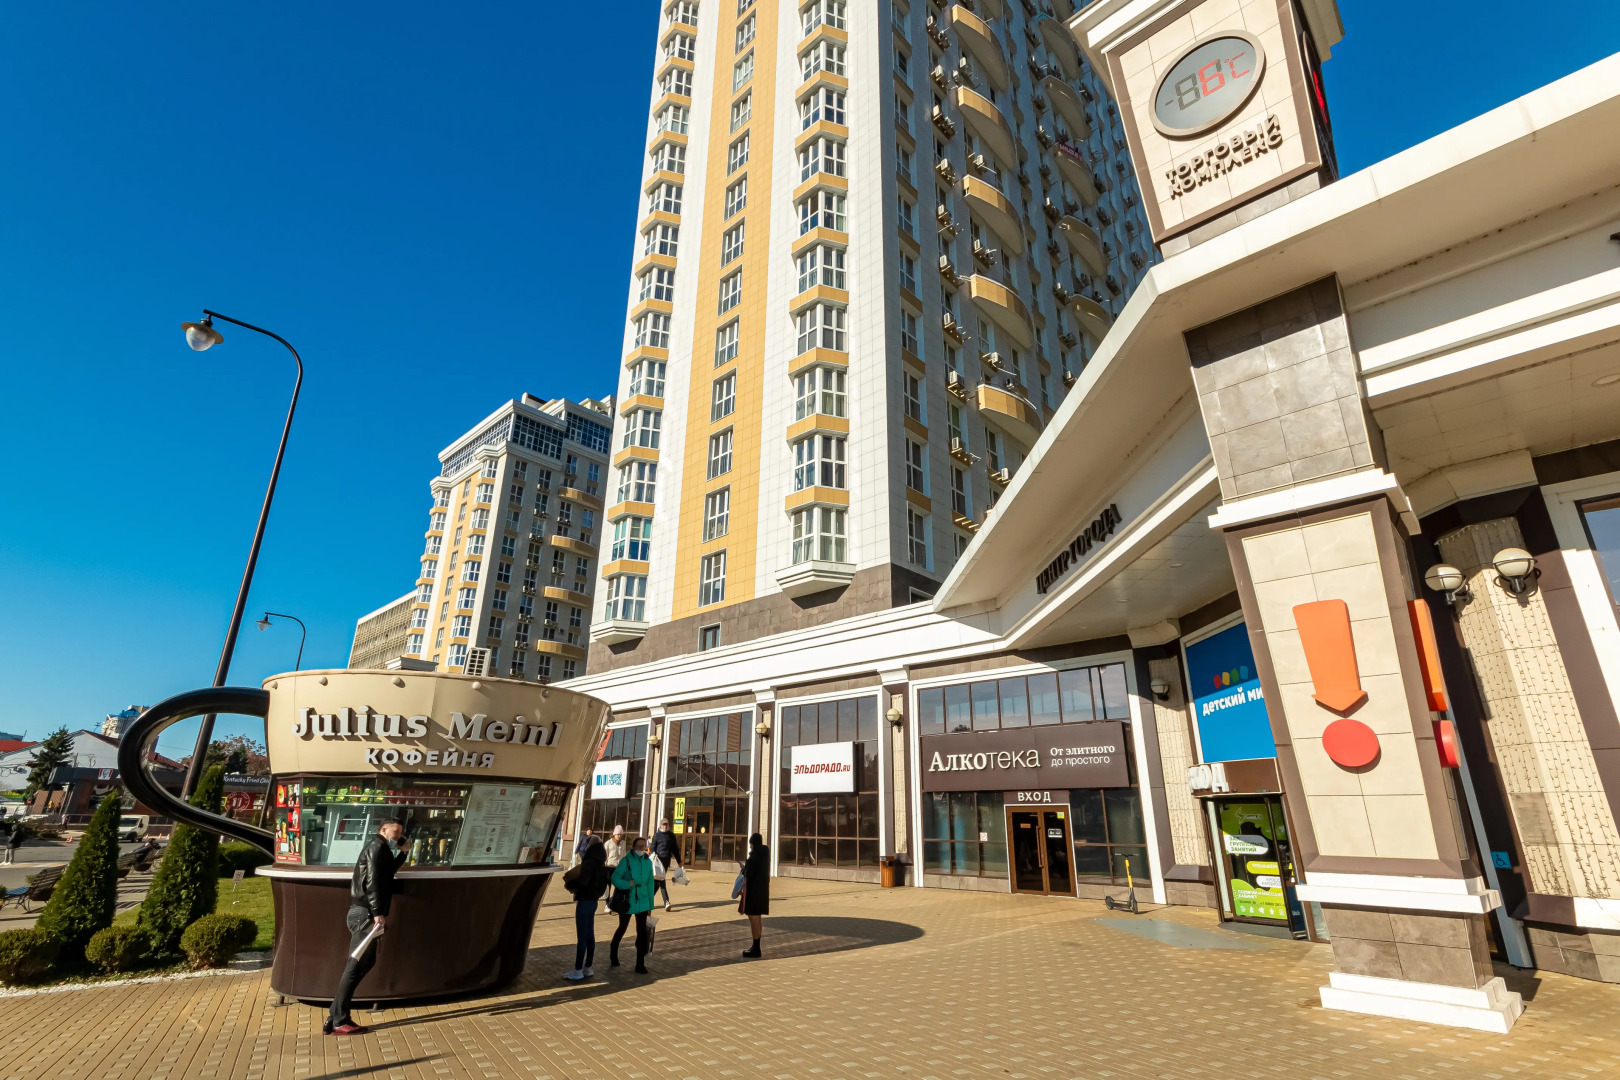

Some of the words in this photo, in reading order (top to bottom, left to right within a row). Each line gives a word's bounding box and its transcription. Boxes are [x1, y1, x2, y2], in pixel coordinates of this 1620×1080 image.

[1165, 113, 1281, 184] ТОРГОВЫЙ
[1168, 131, 1283, 200] КОМПЛЕКС
[1247, 687, 1265, 702] ми
[292, 706, 428, 739] Julius
[447, 711, 564, 748] Meinl
[364, 748, 495, 769] КОФЕЙНЯ
[1050, 746, 1064, 756] От
[1065, 744, 1115, 757] элитного
[928, 748, 1041, 772] Алкотека
[1051, 757, 1063, 767] до
[1066, 756, 1111, 767] простого
[1017, 791, 1052, 803] ВХОД
[676, 801, 685, 817] 10
